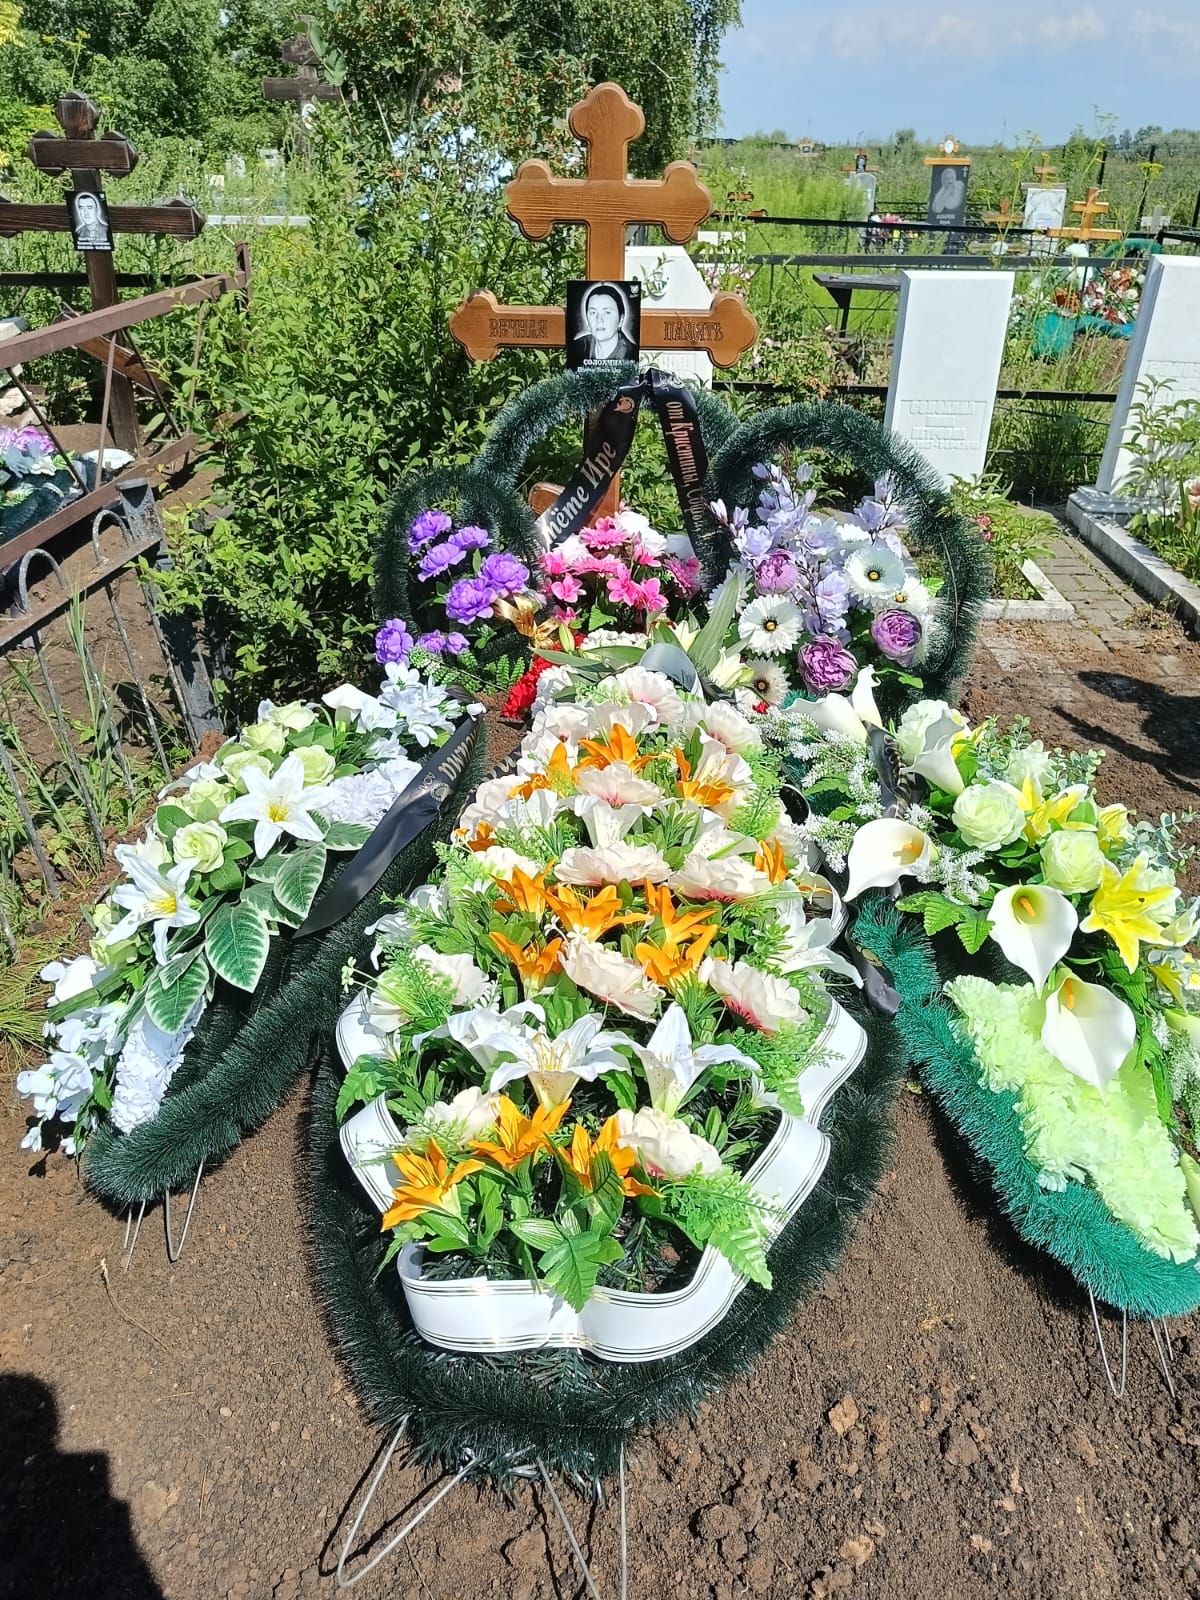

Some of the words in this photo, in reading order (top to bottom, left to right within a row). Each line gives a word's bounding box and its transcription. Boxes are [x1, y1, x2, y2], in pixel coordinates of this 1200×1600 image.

[488, 319, 549, 339] ВЕЧНАЯ
[663, 321, 724, 342] ПАМЯТЬ
[666, 401, 684, 420] от
[580, 441, 618, 491] Ире
